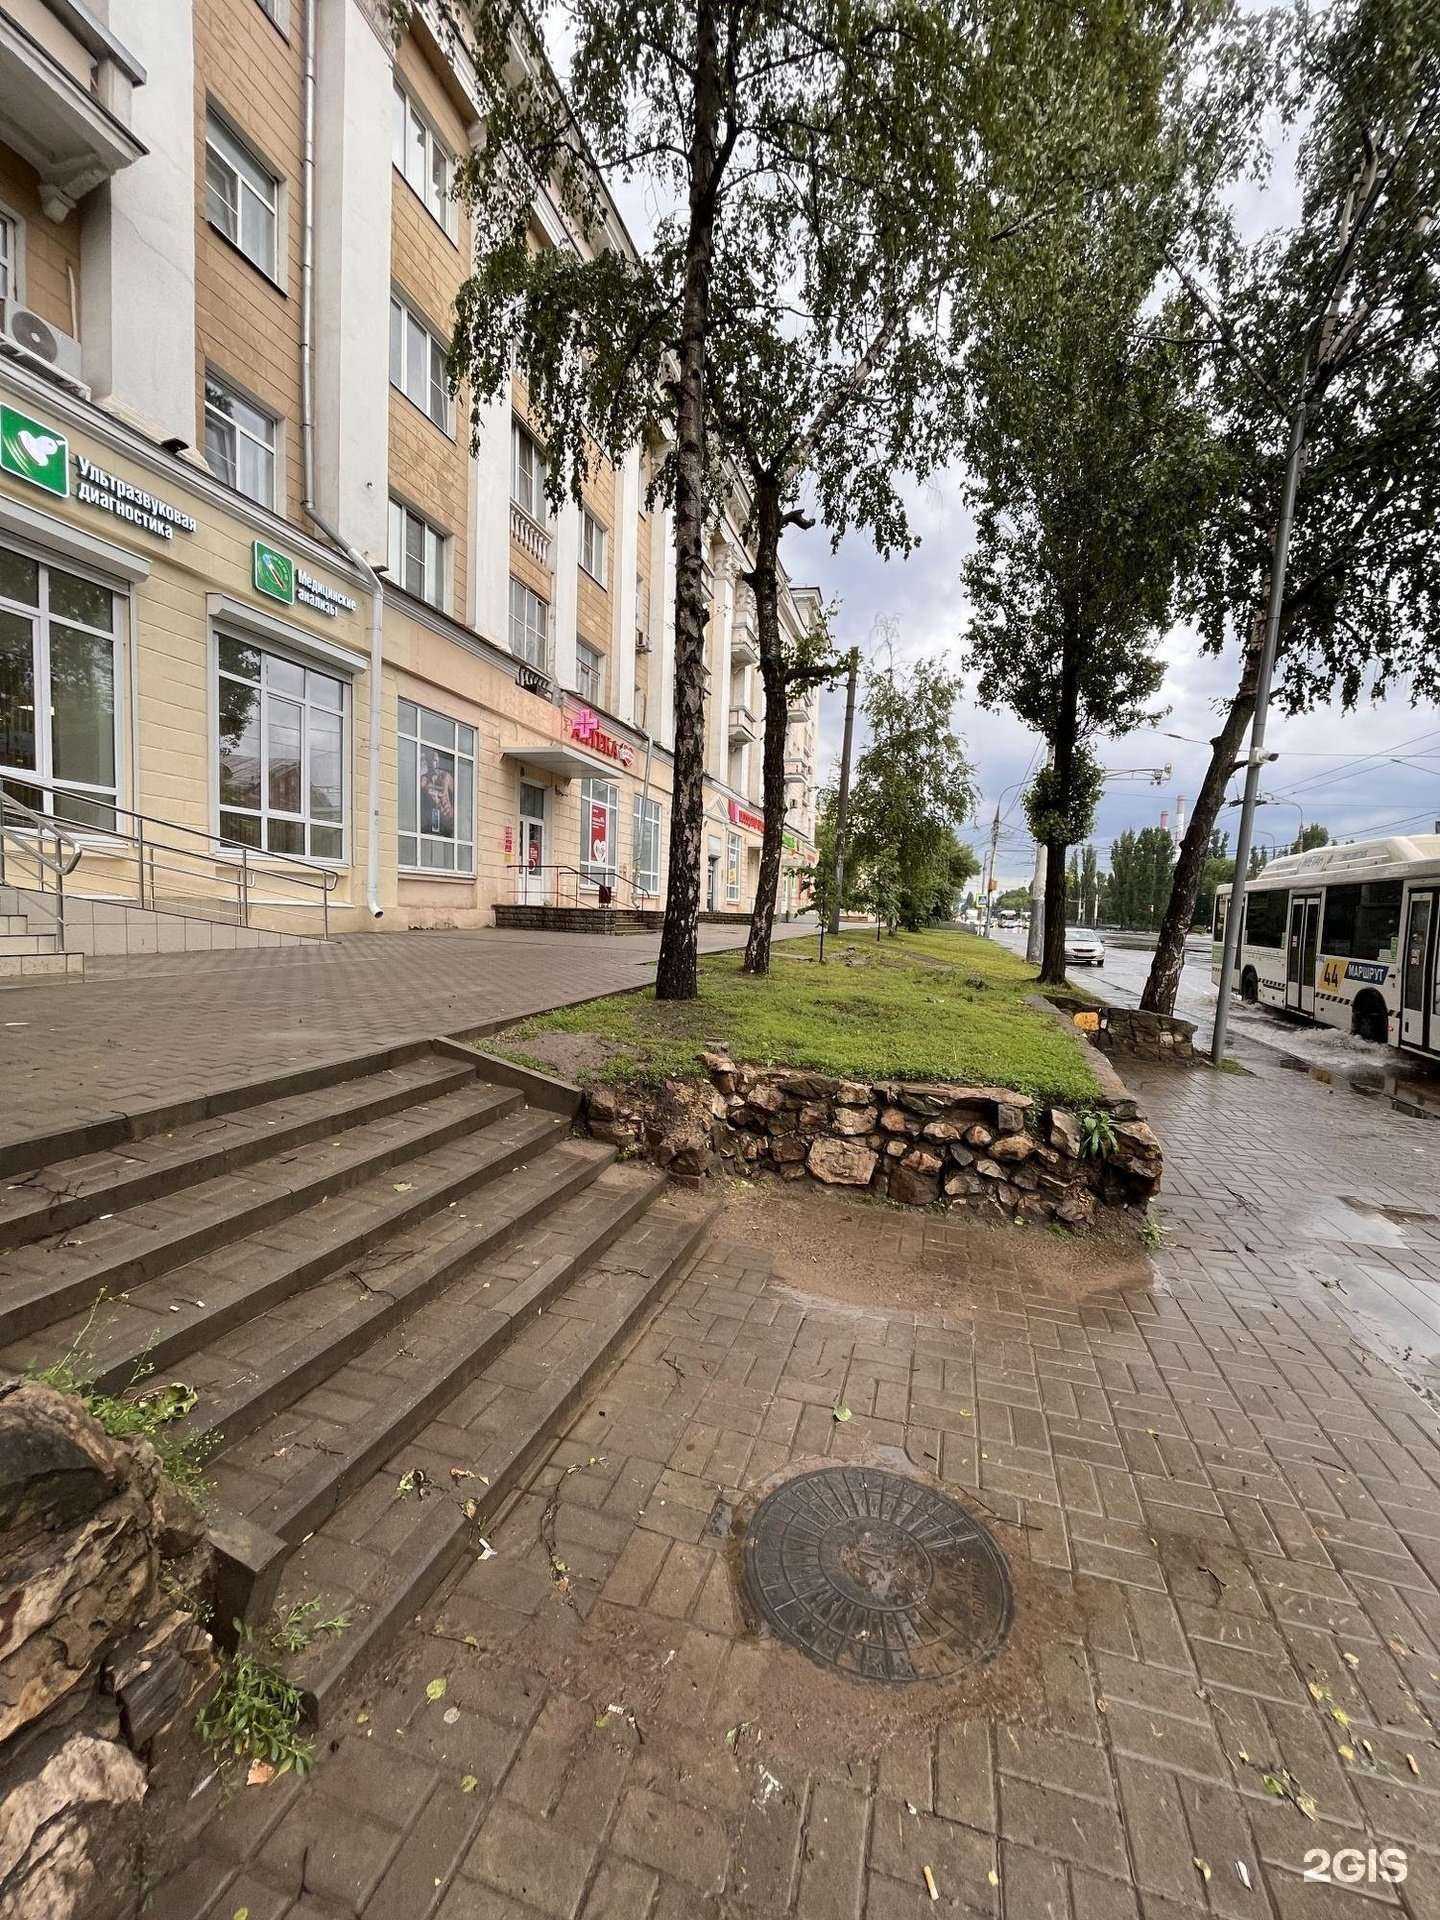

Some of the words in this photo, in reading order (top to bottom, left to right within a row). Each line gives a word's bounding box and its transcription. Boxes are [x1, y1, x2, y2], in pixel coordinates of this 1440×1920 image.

[78, 455, 197, 532] Ультразвуковая
[78, 482, 173, 539] диагностика
[297, 588, 338, 617] анализы
[1323, 963, 1339, 988] 44
[1347, 963, 1384, 982] МАРШРУТ
